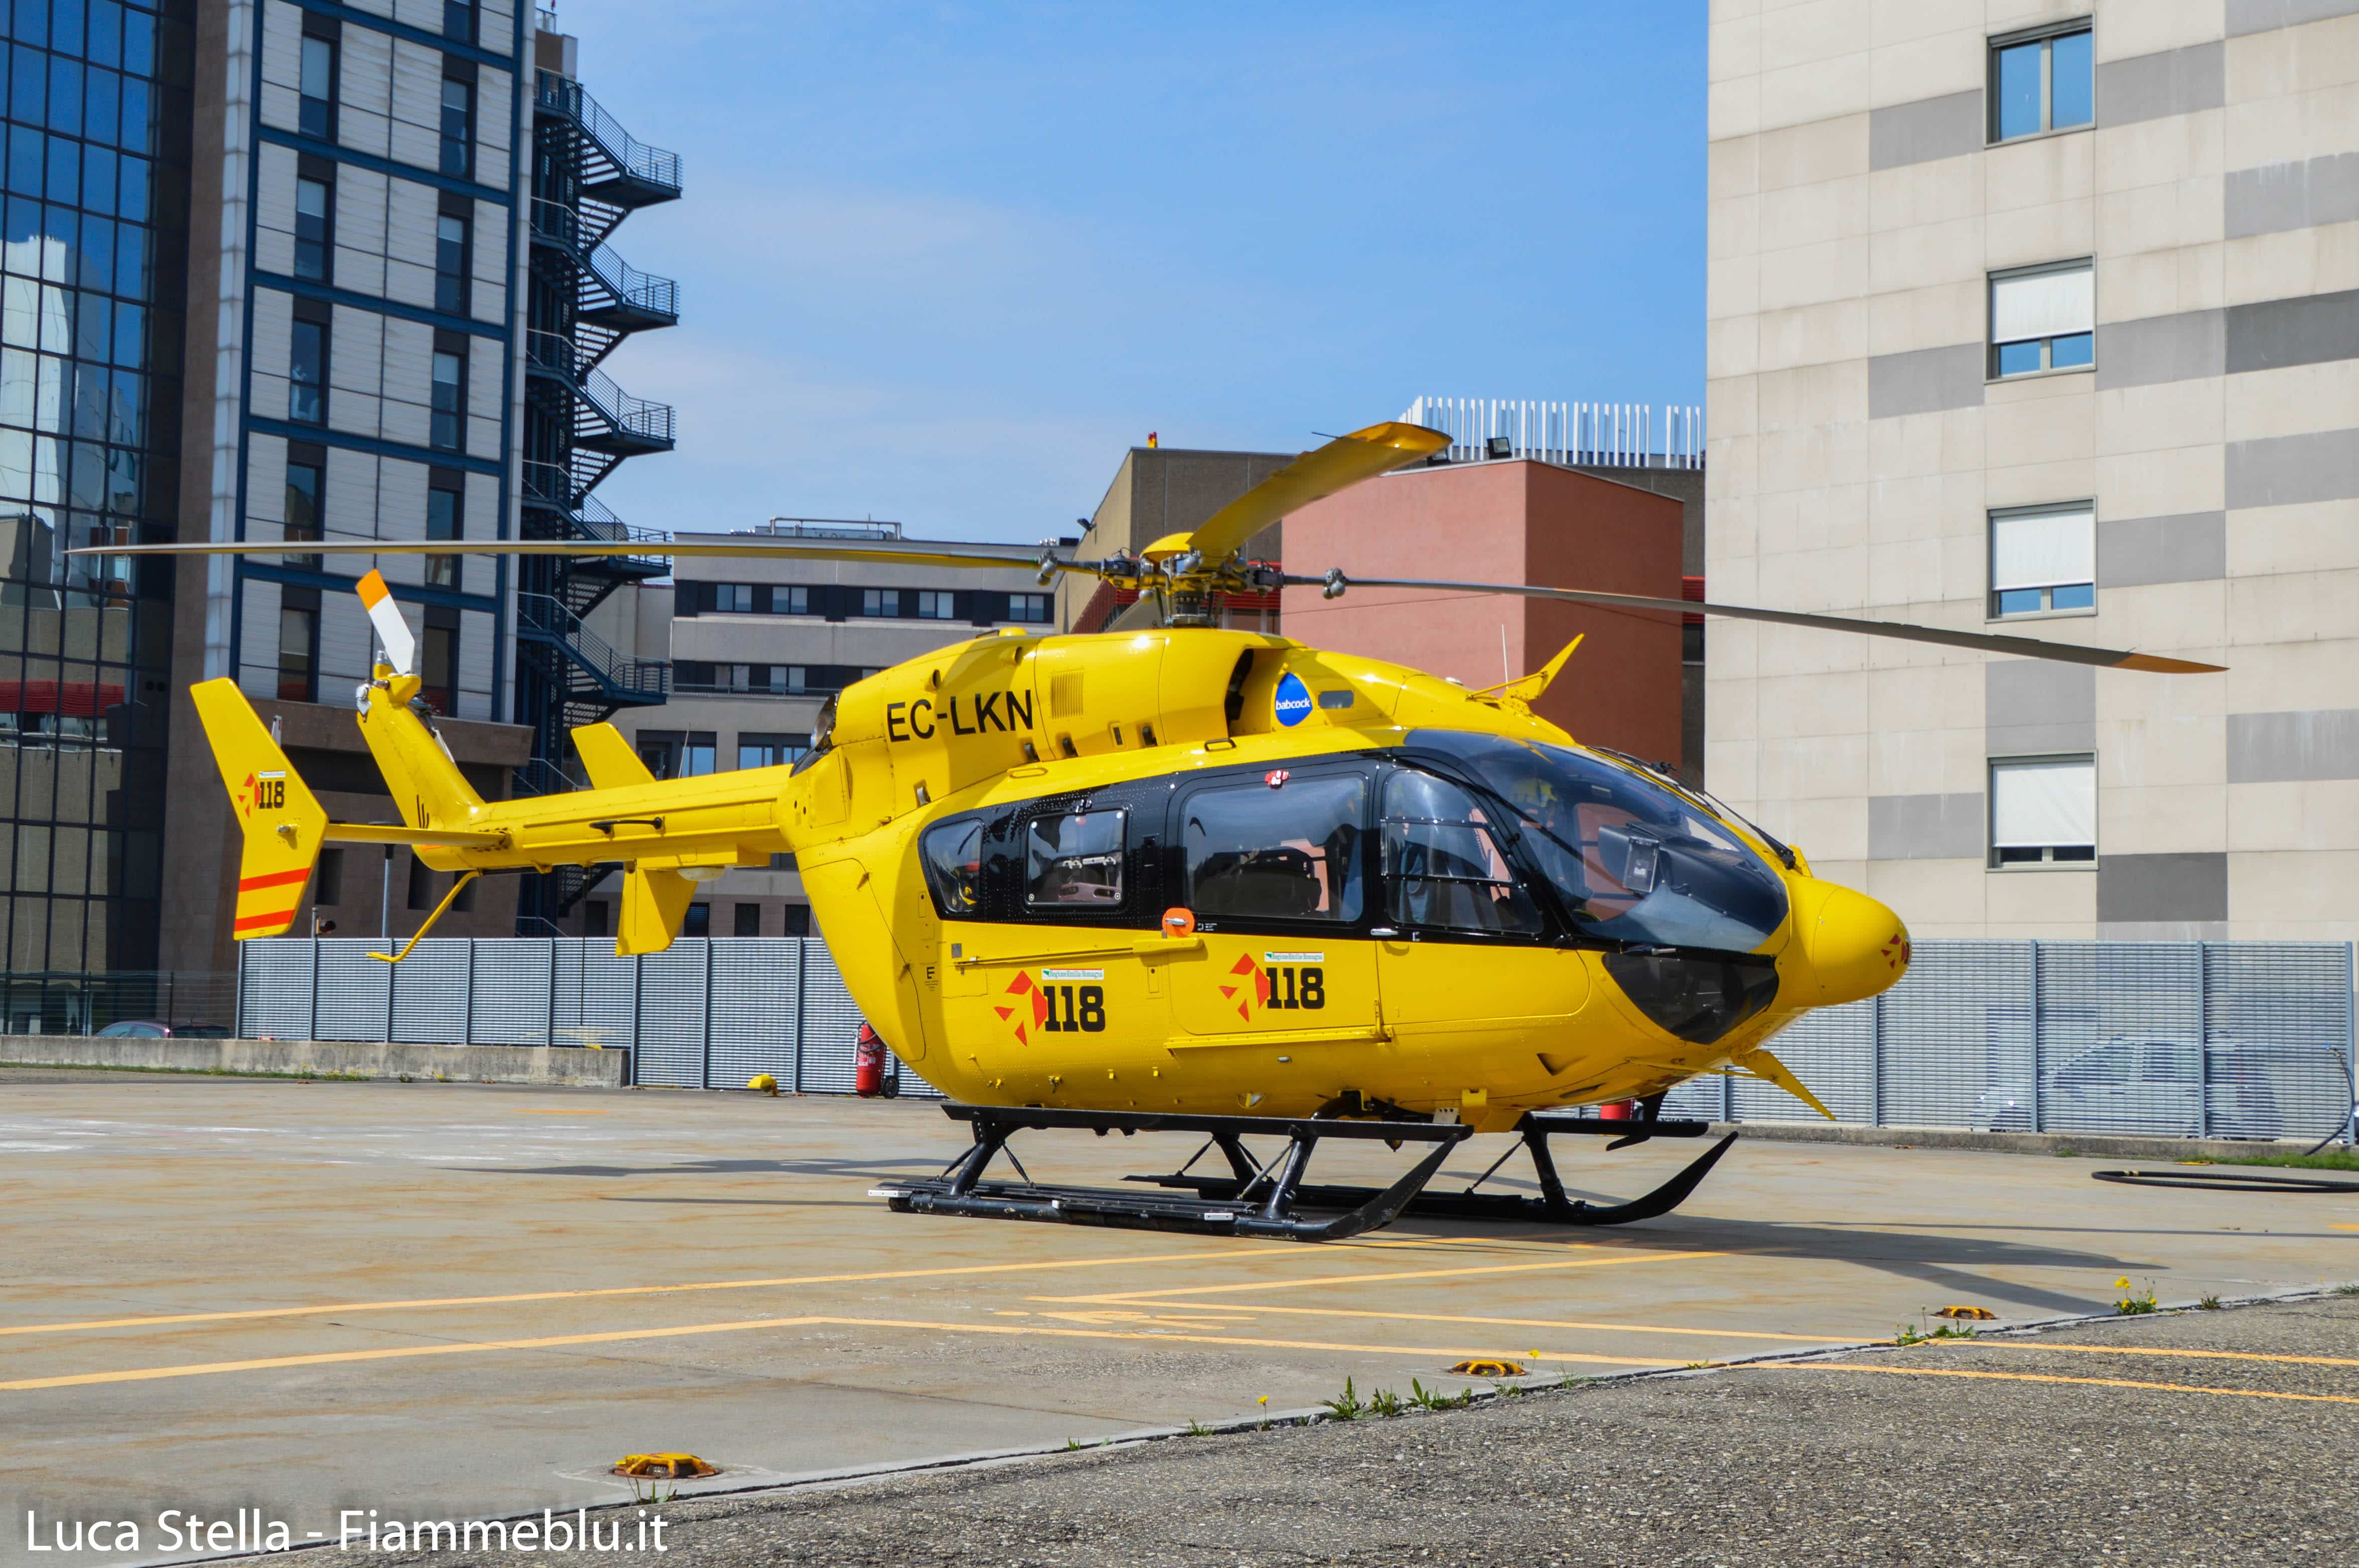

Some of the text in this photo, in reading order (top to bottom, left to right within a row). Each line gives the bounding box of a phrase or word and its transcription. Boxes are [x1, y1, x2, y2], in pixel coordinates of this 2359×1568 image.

[887, 689, 1033, 742] EC-LKN
[1275, 698, 1310, 710] babcock
[259, 781, 284, 809] 118
[1043, 986, 1106, 1032] 118
[1266, 967, 1325, 1009] 118
